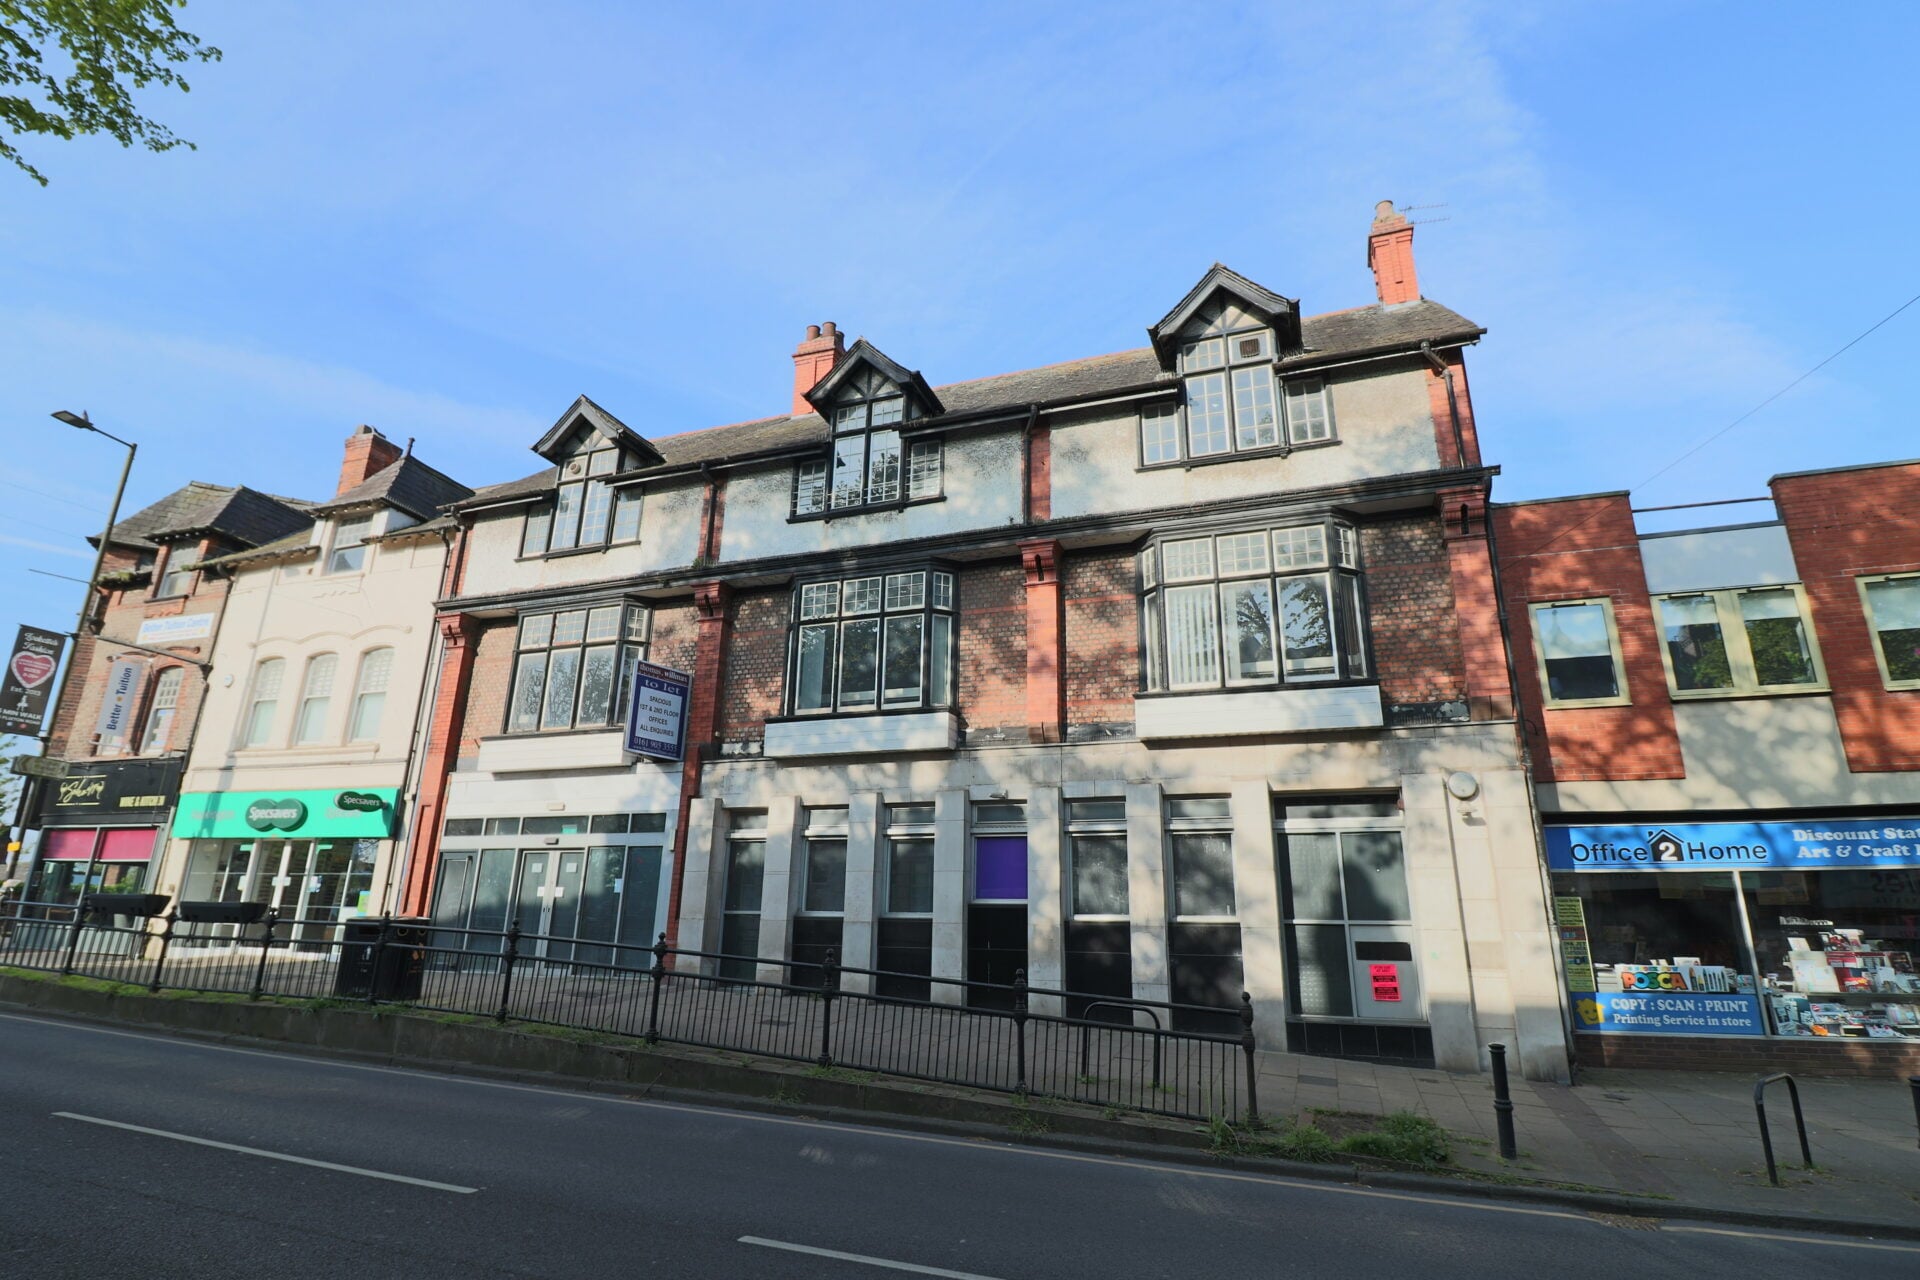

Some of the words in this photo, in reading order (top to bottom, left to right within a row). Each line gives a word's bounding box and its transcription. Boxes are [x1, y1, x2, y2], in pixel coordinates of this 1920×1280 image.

[115, 667, 133, 695] Tuition
[645, 680, 658, 688] to
[663, 683, 680, 695] let
[649, 696, 672, 706] SPACIOUS
[2, 708, 20, 717] MIN
[20, 711, 42, 720] WALK
[106, 704, 123, 731] Better
[664, 709, 679, 717] FLOOR
[649, 716, 667, 725] OFFICES
[650, 726, 674, 737] ENQUIRIES
[634, 737, 648, 747] 0161
[343, 795, 380, 807] Specsavers
[248, 806, 298, 821] Specsavers
[1792, 828, 1879, 842] Discount
[1570, 843, 1648, 862] Office
[1658, 841, 1679, 861] 2
[1687, 841, 1768, 860] Home
[1797, 846, 1832, 858] Art
[1835, 845, 1852, 857] &
[1858, 844, 1911, 857] Craft
[1621, 971, 1688, 990] POSCA
[1611, 997, 1647, 1011] COPY
[1657, 999, 1695, 1011] SCAN
[1706, 1000, 1748, 1013] PRINT
[1614, 1013, 1661, 1027] Printing
[1663, 1014, 1705, 1026] Service
[1707, 1015, 1719, 1026] in
[1721, 1016, 1752, 1027] store
